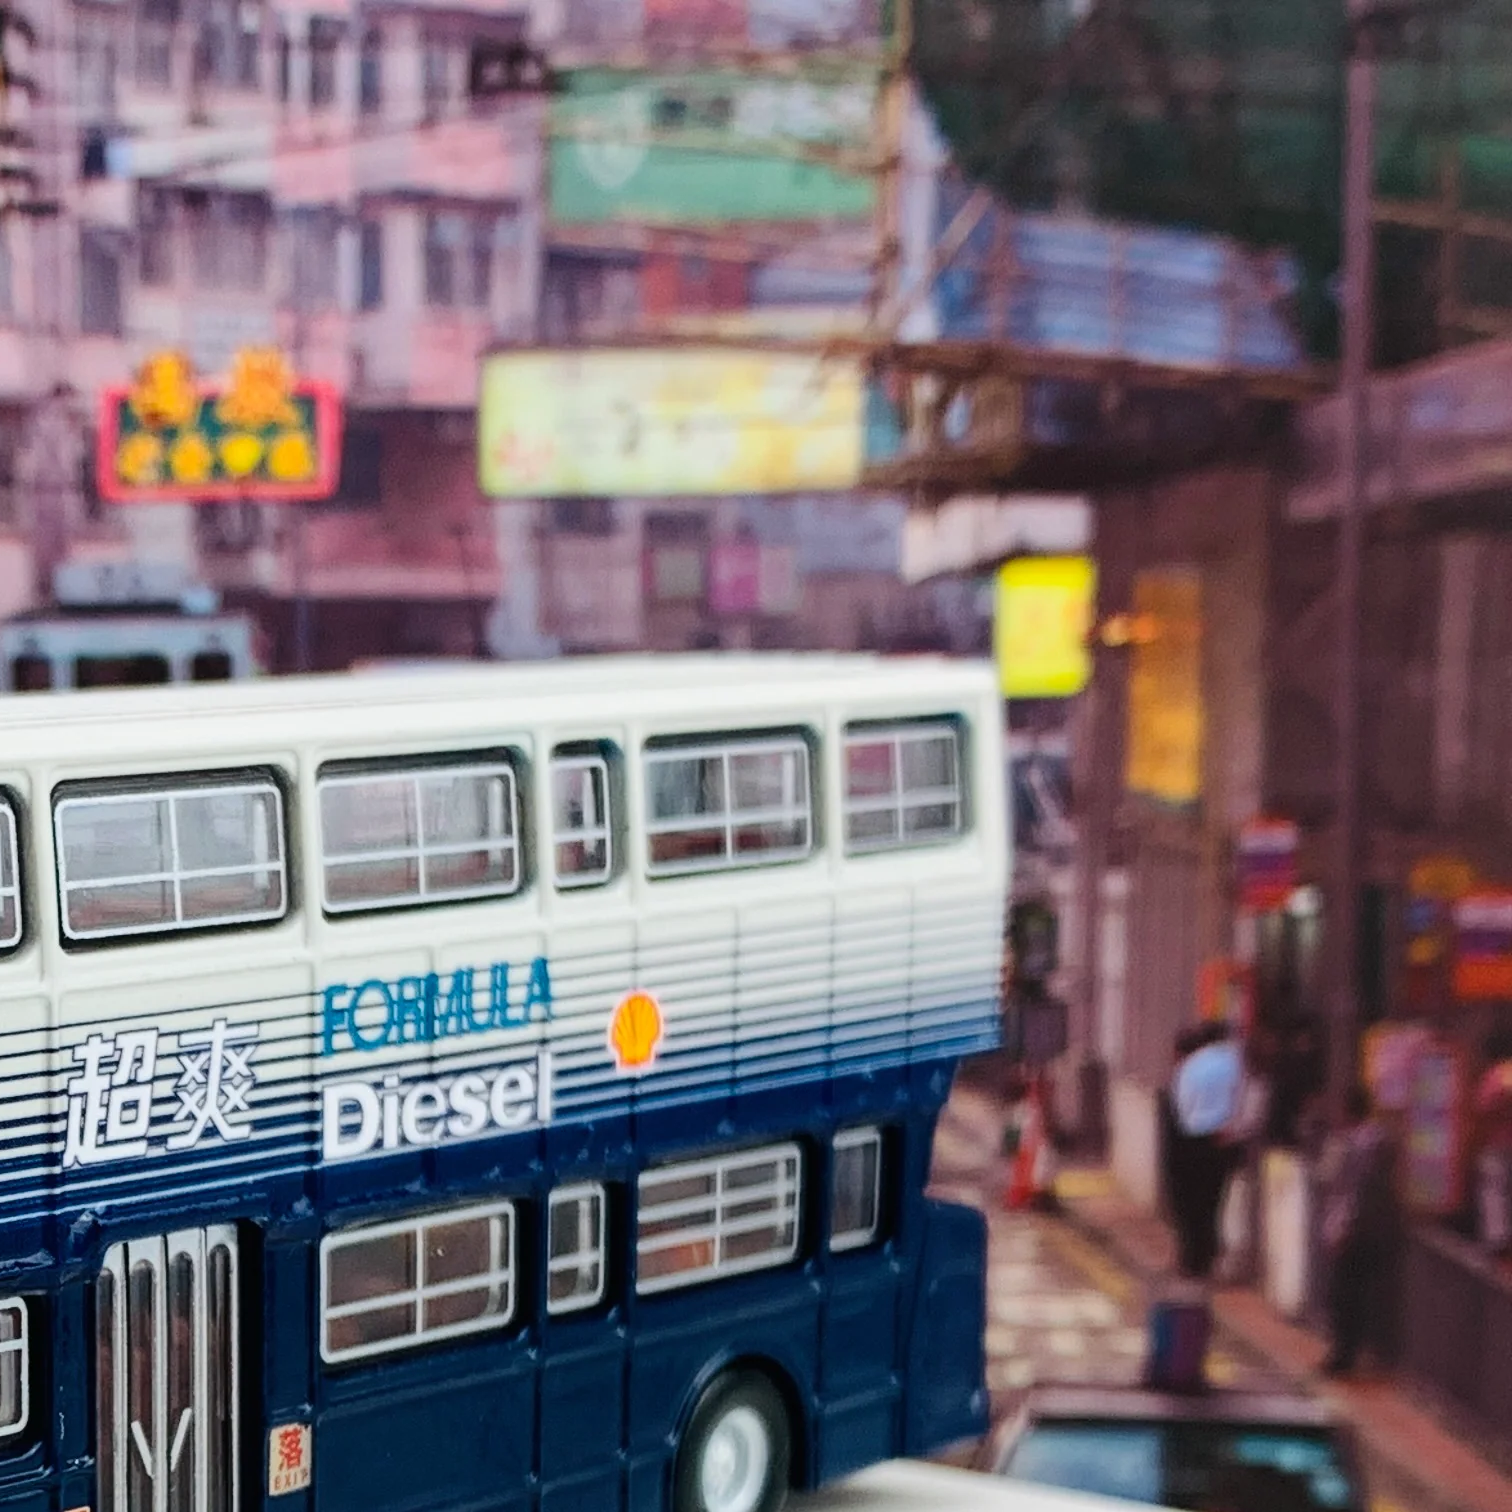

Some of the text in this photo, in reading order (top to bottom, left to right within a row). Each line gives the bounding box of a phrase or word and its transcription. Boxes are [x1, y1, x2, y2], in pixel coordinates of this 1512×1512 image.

[321, 957, 555, 1057] FORMULA
[62, 1017, 261, 1171] 超爽
[321, 1049, 553, 1162] Diesel
[278, 1428, 304, 1472] 落
